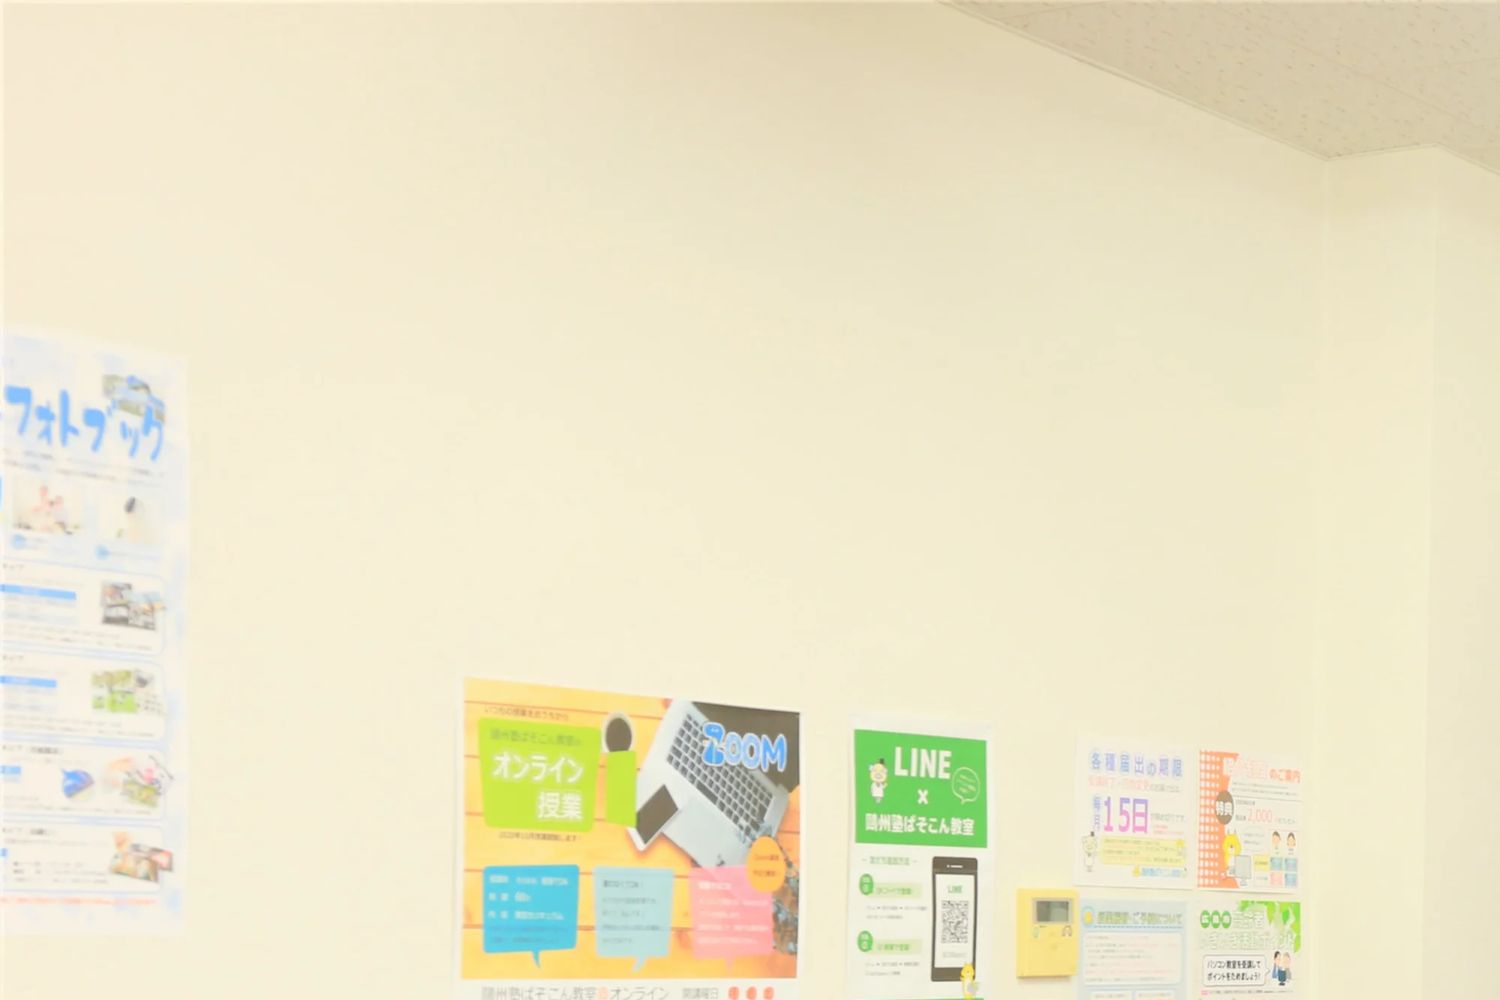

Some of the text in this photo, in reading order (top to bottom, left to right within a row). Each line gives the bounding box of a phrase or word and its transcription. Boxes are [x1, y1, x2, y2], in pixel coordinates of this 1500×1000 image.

[492, 751, 584, 784] オンライン
[894, 747, 952, 779] LINE
[537, 790, 584, 822] 授業
[1103, 796, 1149, 834] 15日
